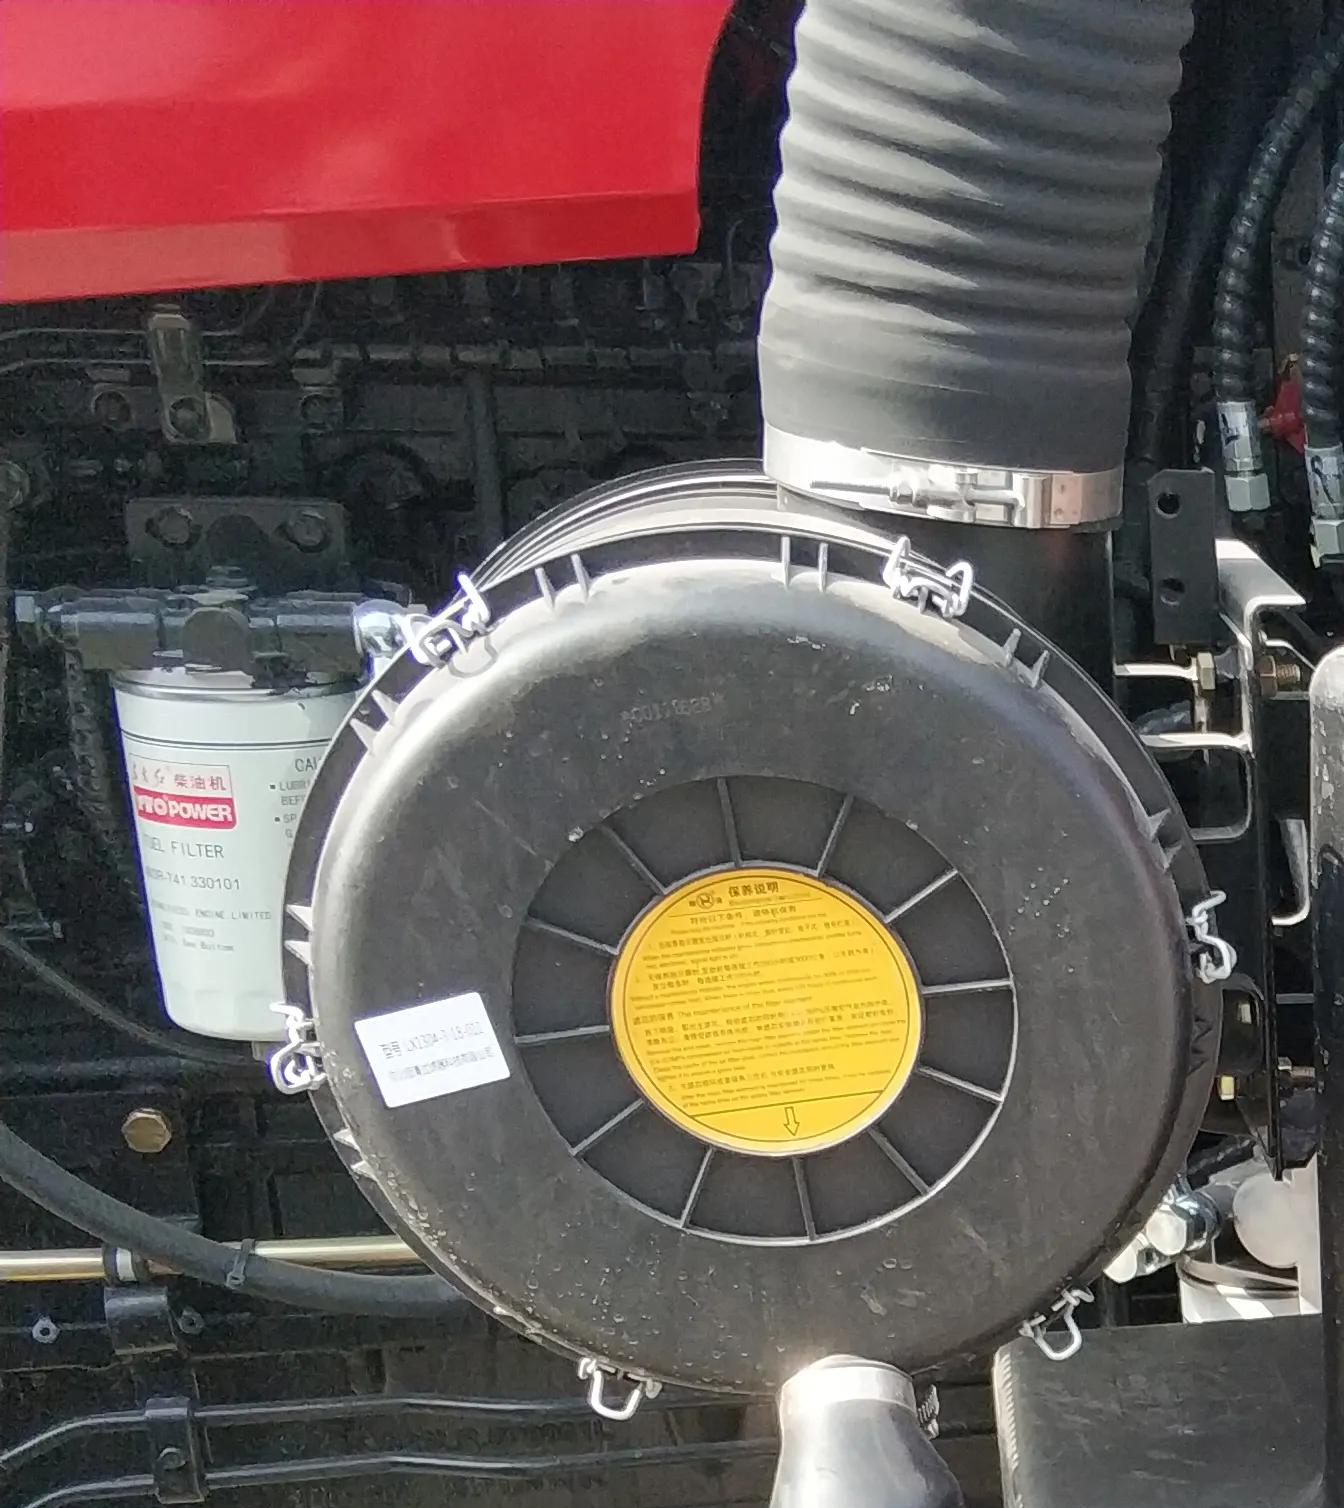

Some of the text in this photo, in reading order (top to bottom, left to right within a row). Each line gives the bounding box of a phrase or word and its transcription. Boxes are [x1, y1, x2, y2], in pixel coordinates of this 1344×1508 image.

[174, 773, 227, 791] 柴油机
[170, 840, 225, 858] FILTER
[728, 881, 780, 898] 保养说明
